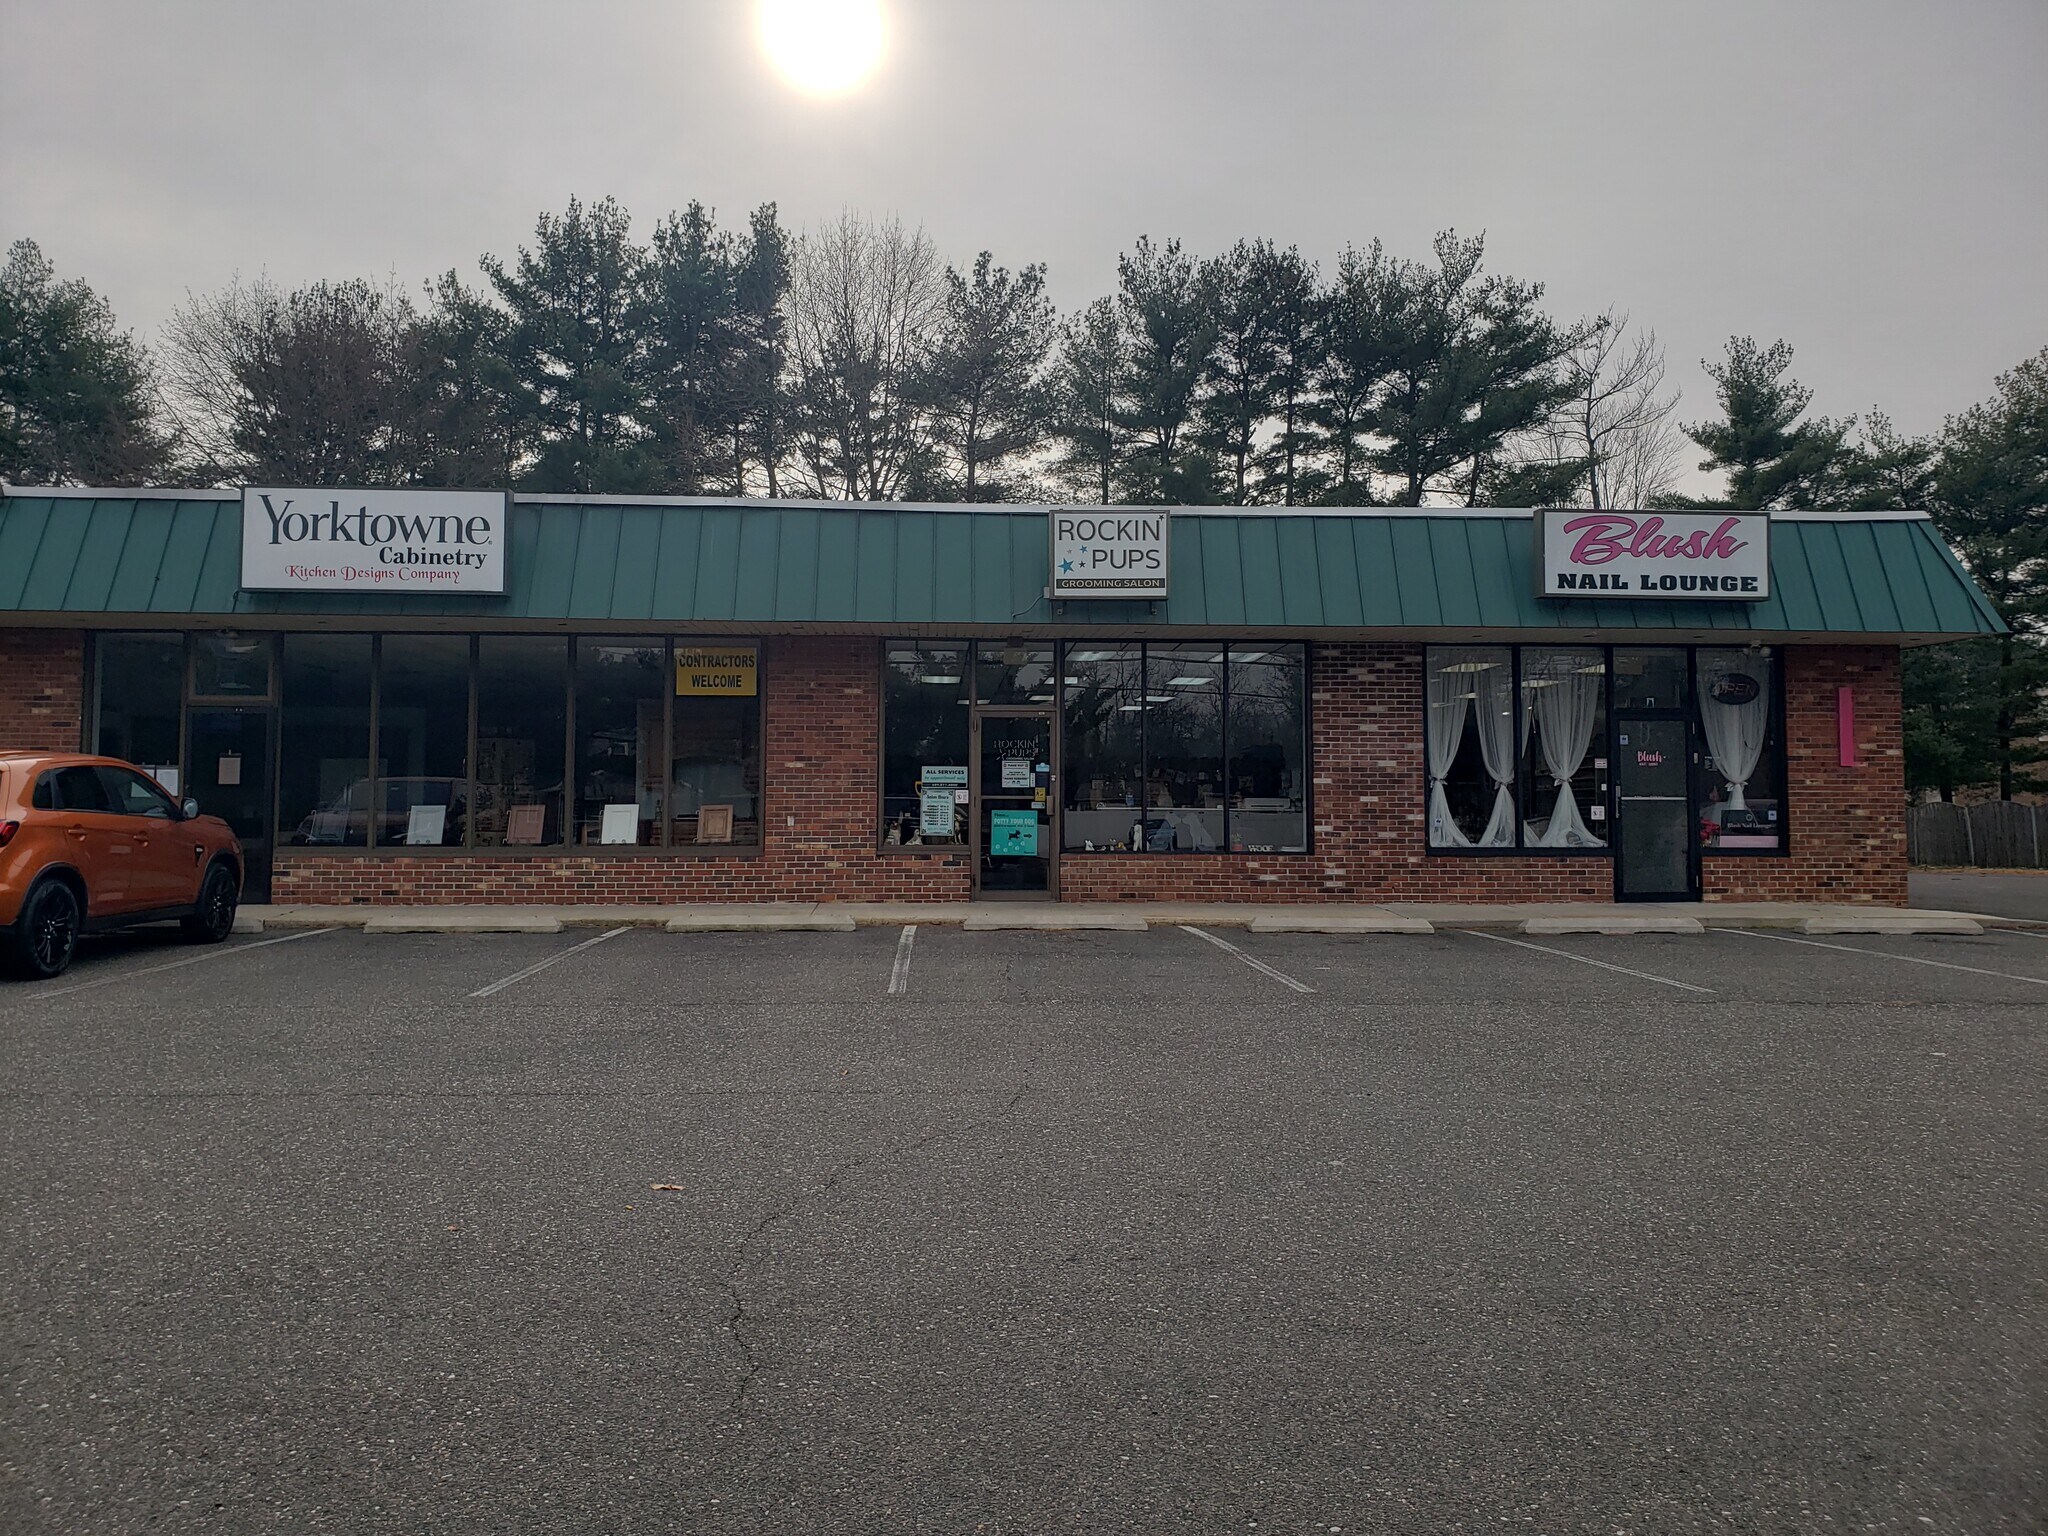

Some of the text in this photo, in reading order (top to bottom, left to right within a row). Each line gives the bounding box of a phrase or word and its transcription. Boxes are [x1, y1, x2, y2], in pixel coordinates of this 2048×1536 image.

[257, 494, 491, 546] Yorktowne
[1058, 519, 1160, 541] ROCKIN
[1563, 515, 1749, 565] Blush
[379, 546, 488, 569] Cabinetry
[1092, 549, 1161, 569] PUPS
[285, 565, 460, 584] Kitchen Designs Company
[1061, 579, 1160, 588] GROOMING SALON
[1557, 573, 1758, 592] NAIL LOUNGE
[679, 654, 755, 668] CONTRACTORS
[691, 674, 742, 688] WELCOME
[1637, 750, 1662, 763] Blush
